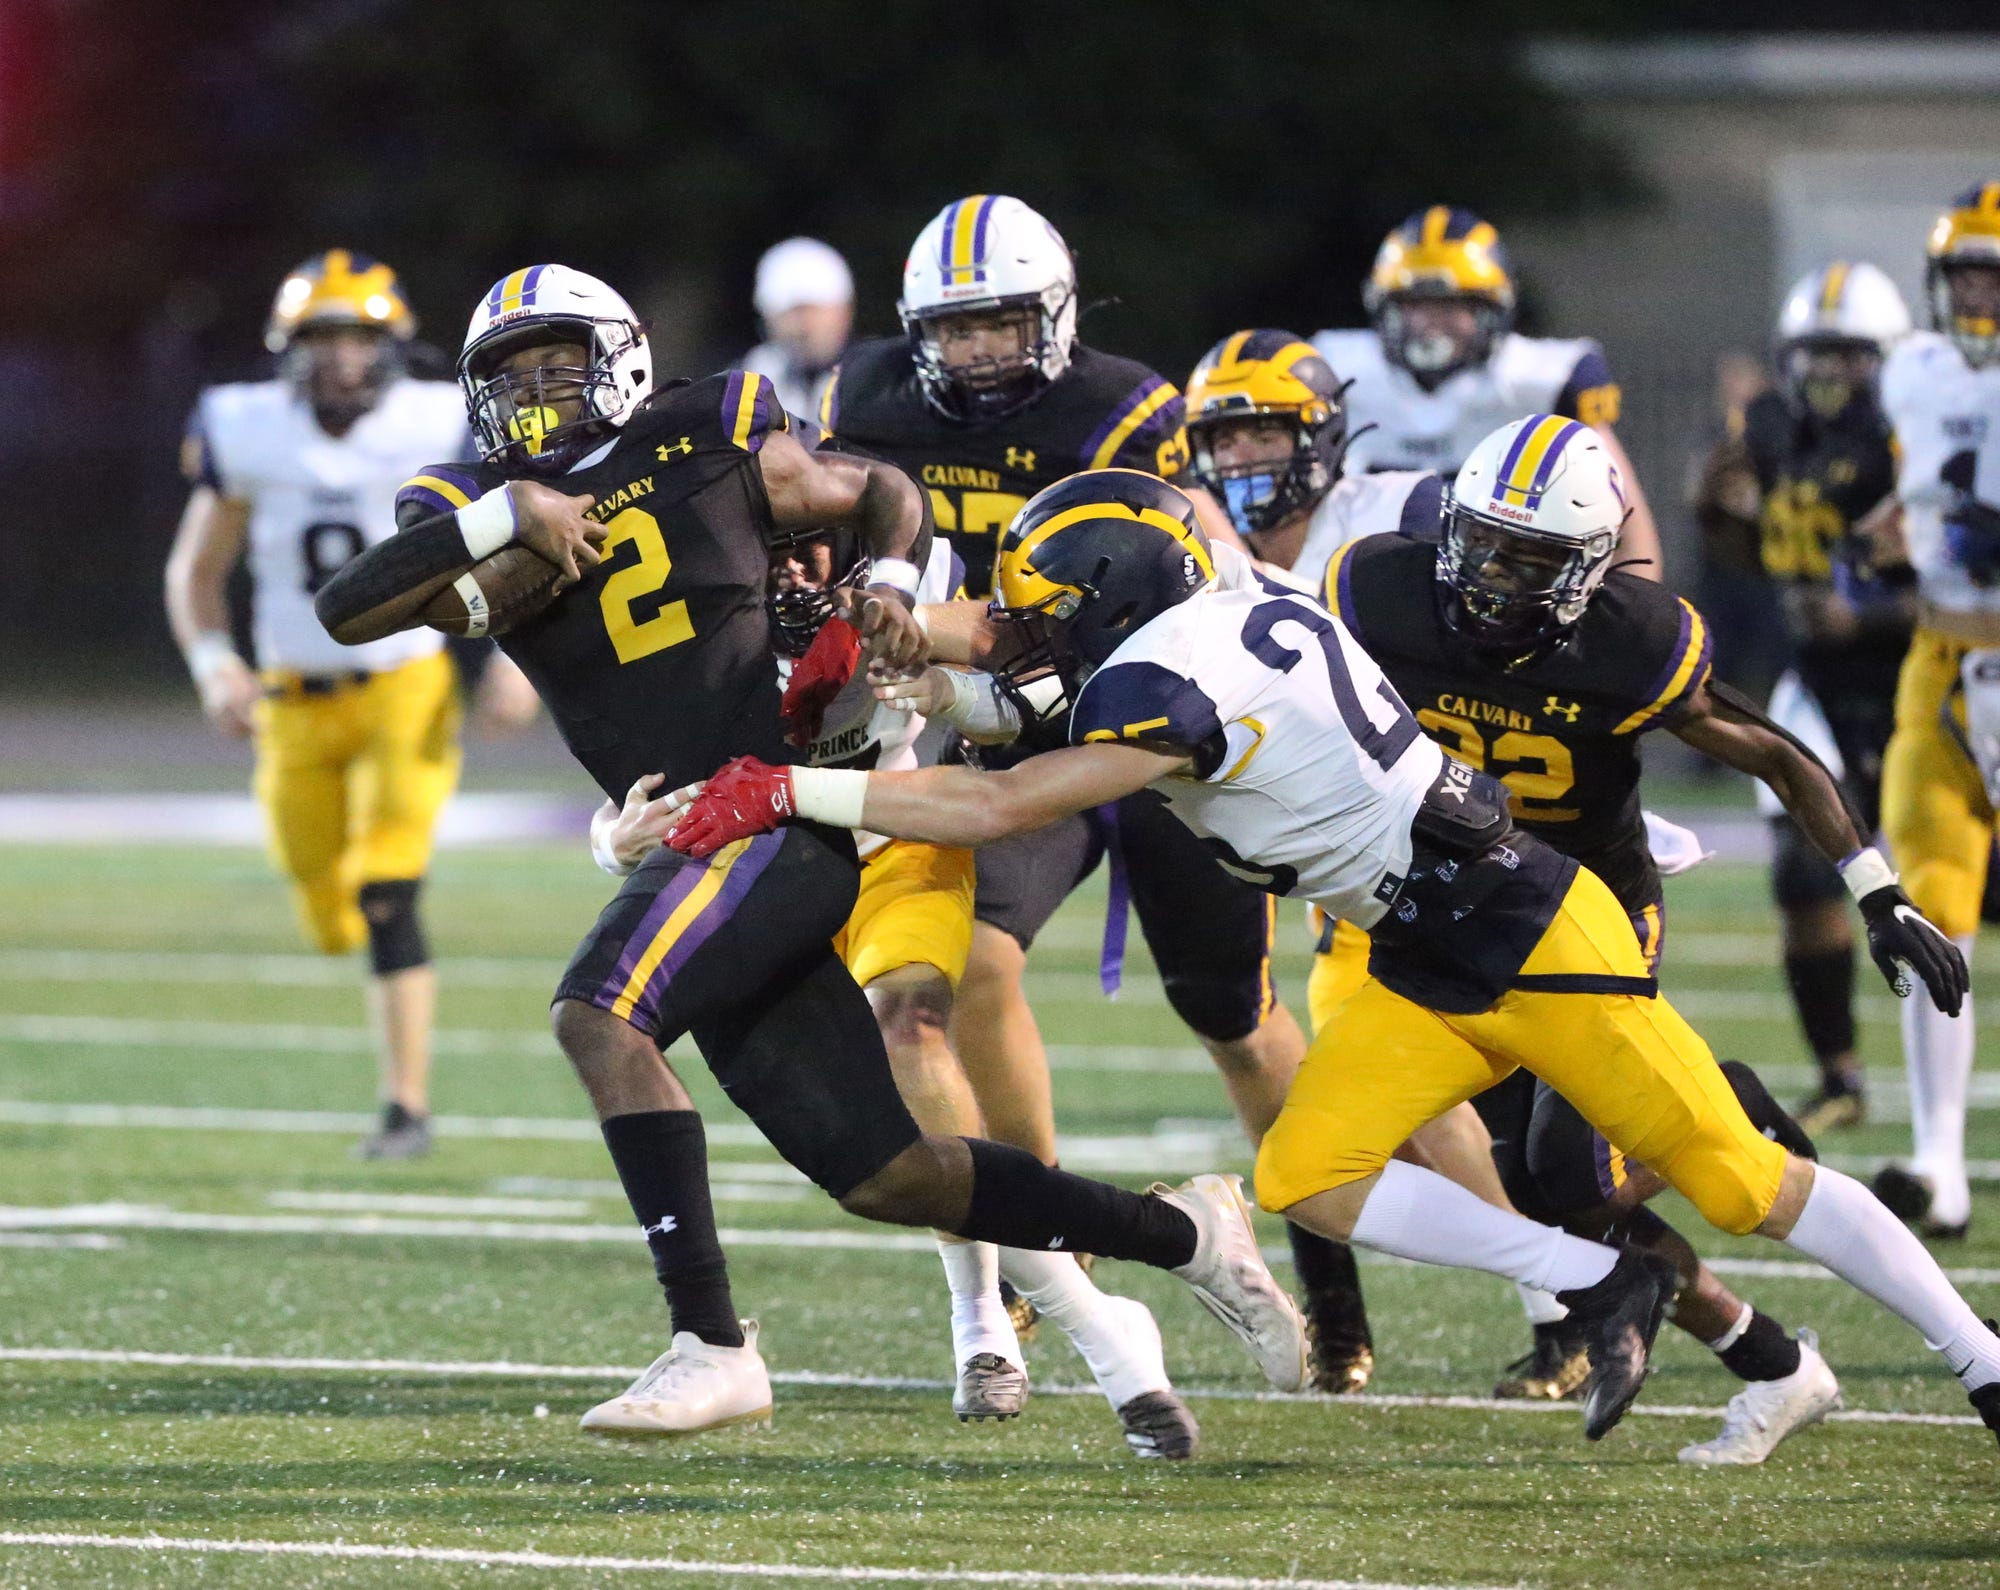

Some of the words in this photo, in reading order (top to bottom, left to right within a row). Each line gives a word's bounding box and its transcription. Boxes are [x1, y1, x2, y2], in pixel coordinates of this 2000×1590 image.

[584, 476, 655, 525] ALVARY
[1488, 502, 1534, 523] Riddell
[598, 506, 697, 665] 2
